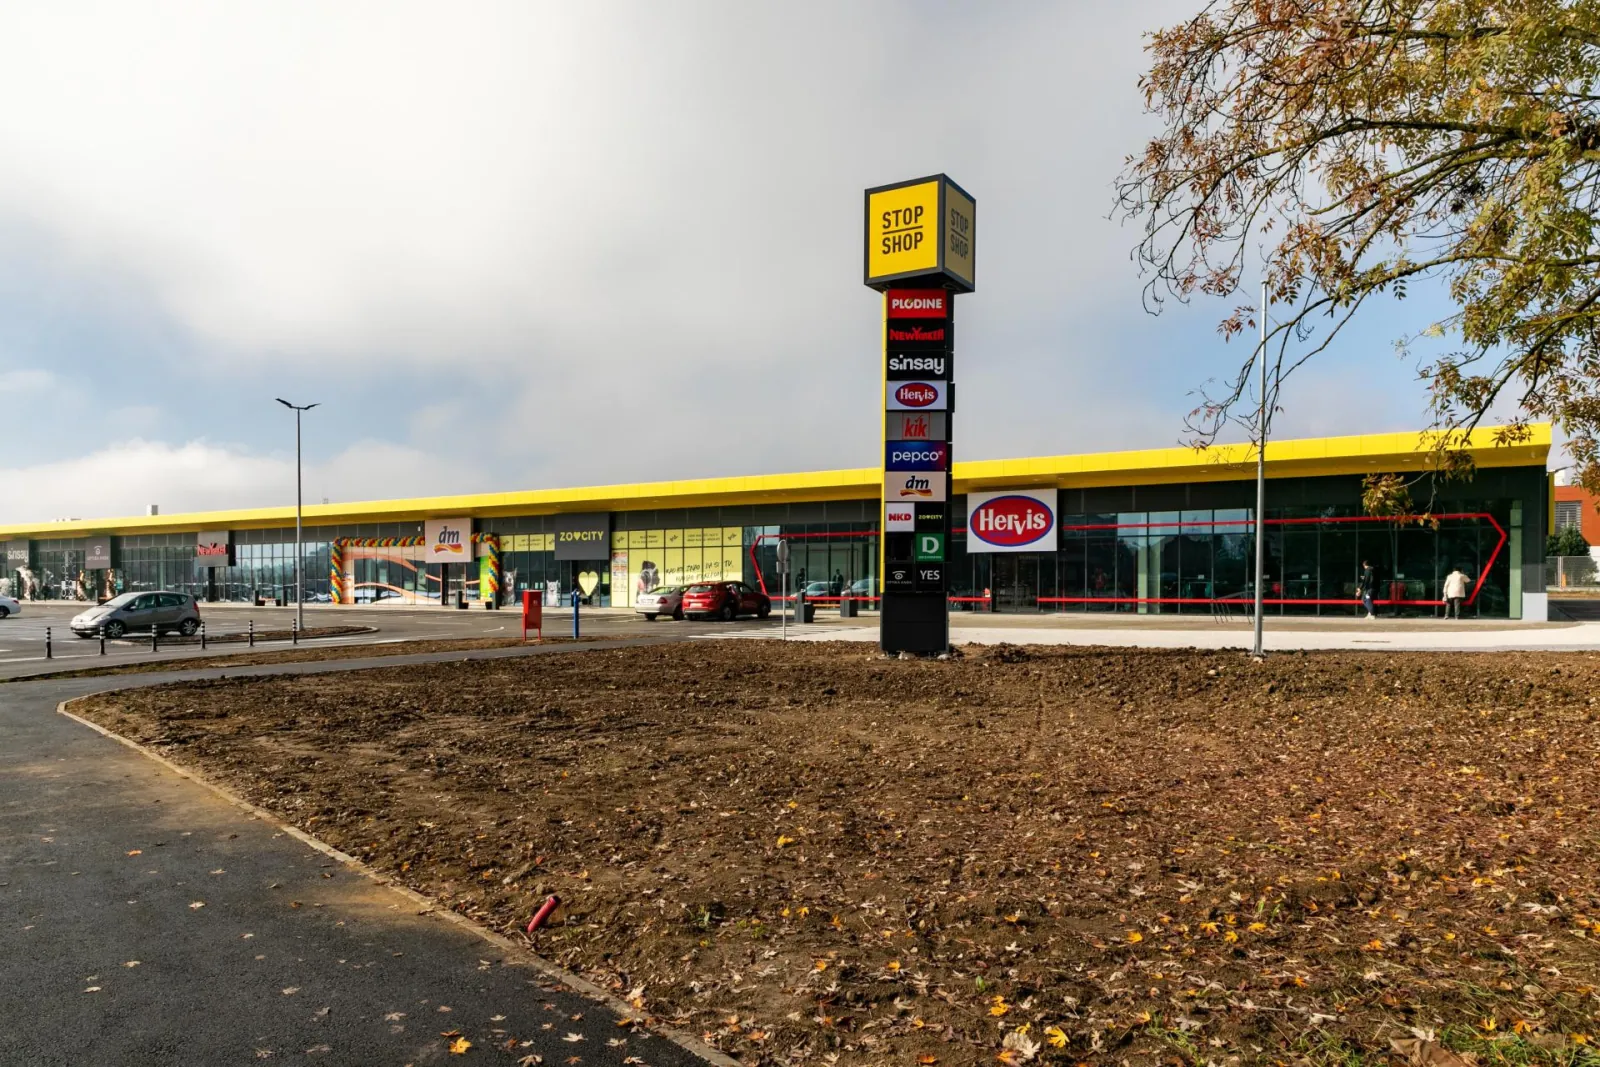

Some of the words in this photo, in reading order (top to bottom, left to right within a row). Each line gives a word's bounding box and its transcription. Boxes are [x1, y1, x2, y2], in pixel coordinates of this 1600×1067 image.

[882, 205, 924, 229] STOP
[951, 208, 969, 234] STOP
[882, 231, 924, 255] SHOP
[950, 234, 969, 260] SHOP
[891, 298, 943, 309] PLODINE
[889, 354, 945, 375] sinsay
[900, 388, 935, 402] Hervis
[892, 451, 939, 464] pepco
[905, 475, 930, 489] dm
[888, 513, 912, 521] NKD
[979, 508, 1047, 535] Hervis
[438, 525, 460, 544] dm
[922, 536, 940, 554] D
[7, 547, 29, 563] sinsay
[920, 570, 940, 580] YES
